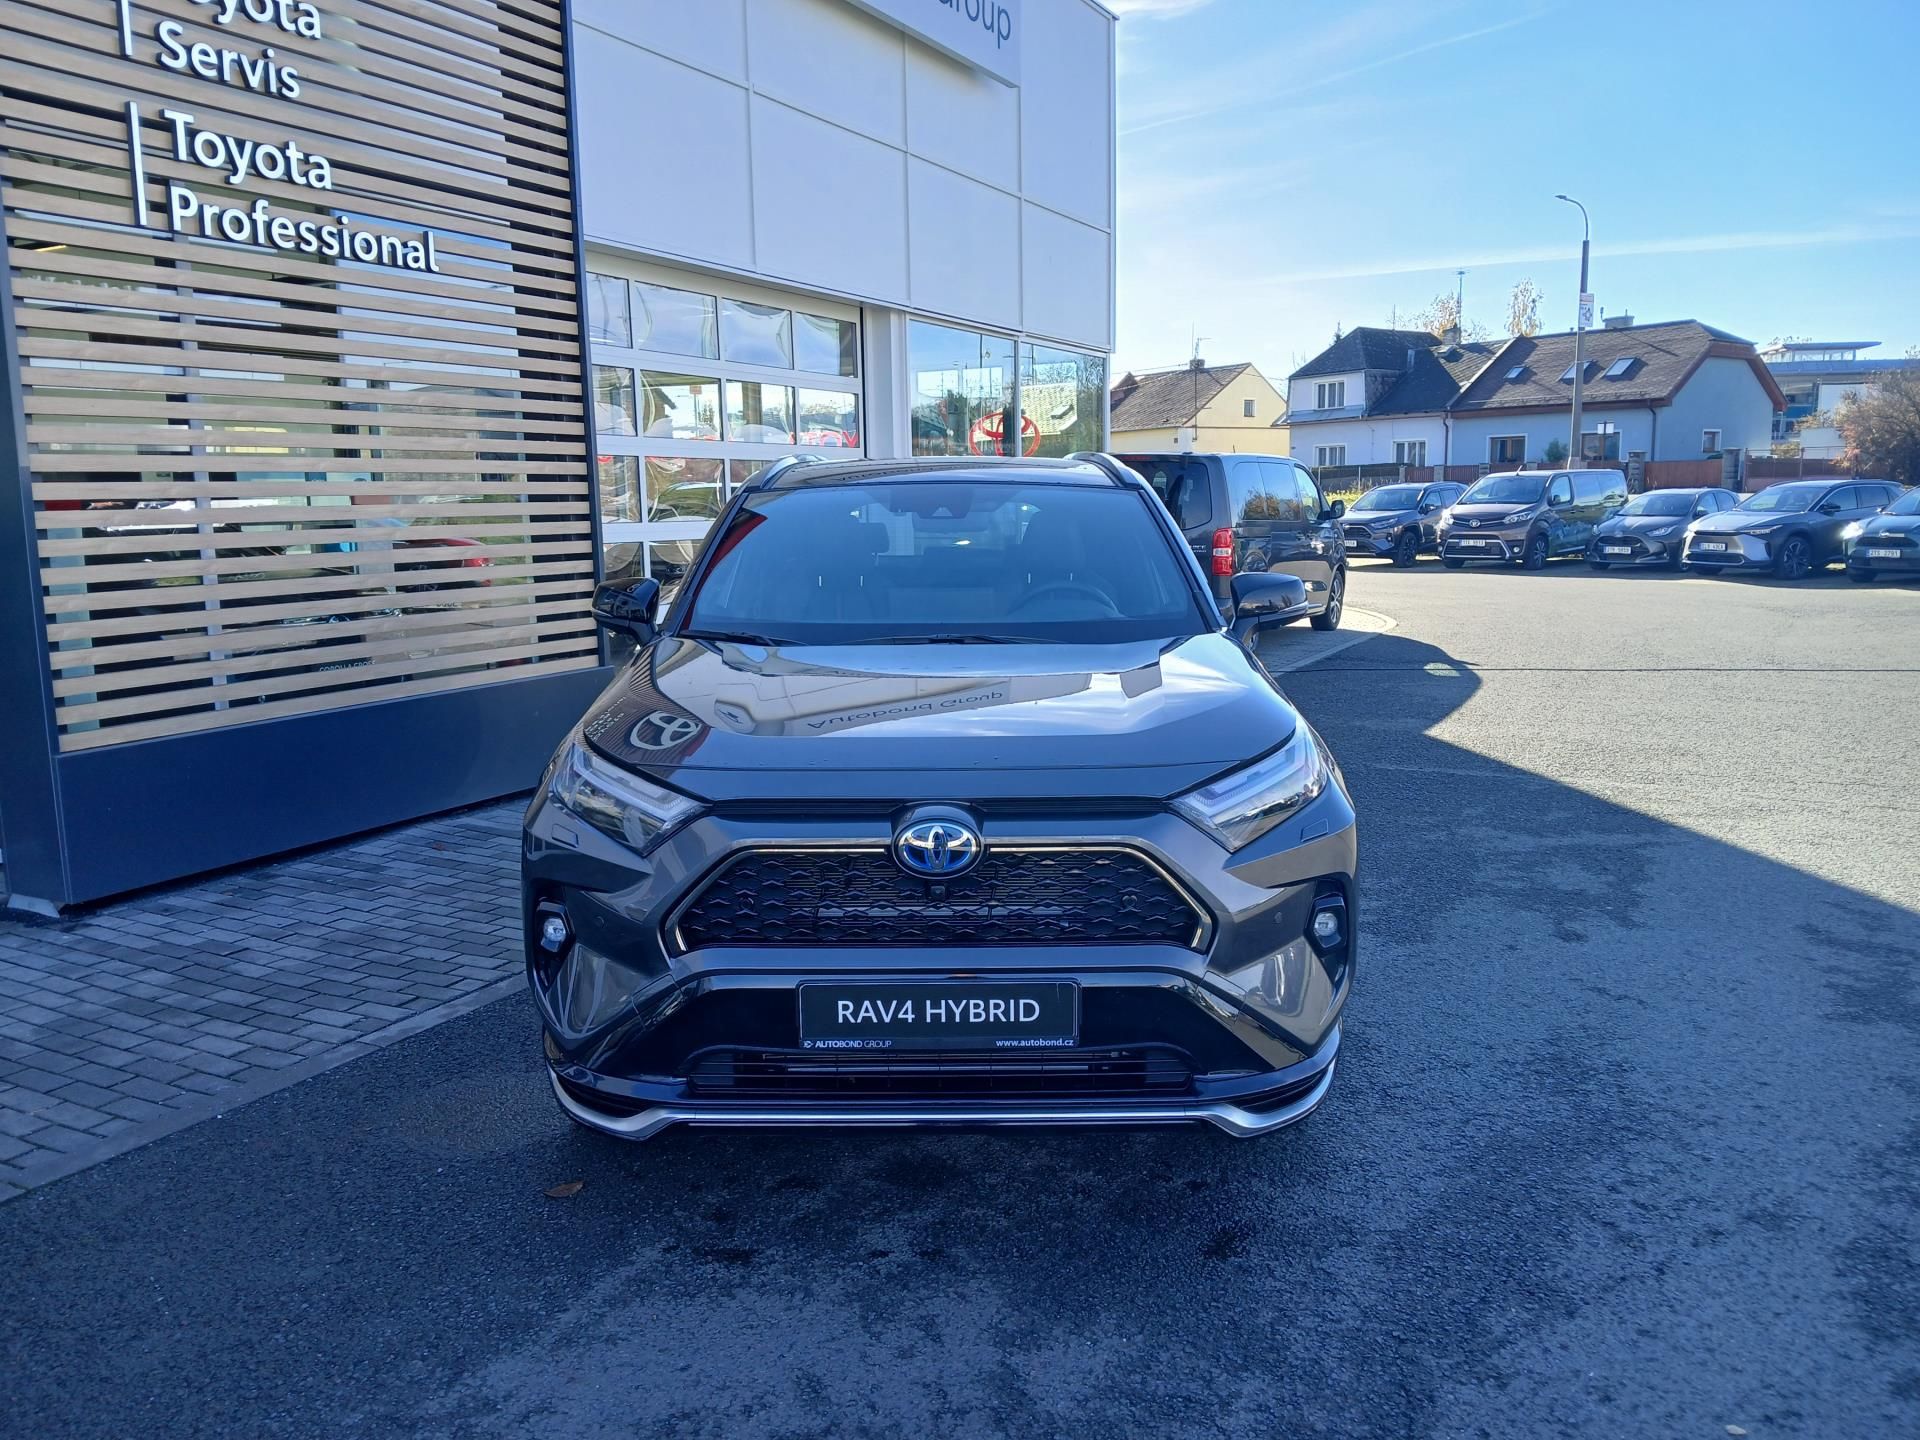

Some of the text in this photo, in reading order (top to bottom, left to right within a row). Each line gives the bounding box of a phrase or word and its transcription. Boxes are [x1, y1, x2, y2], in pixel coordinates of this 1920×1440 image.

[189, 0, 321, 39] yota
[157, 20, 301, 99] Servis
[161, 108, 333, 190] Toyota
[169, 185, 440, 272] Professional
[837, 999, 1041, 1024] RAV4 HYBRID
[814, 1039, 892, 1049] AUTOBOND GROUP
[995, 1038, 1075, 1048] www.autobond.cz
